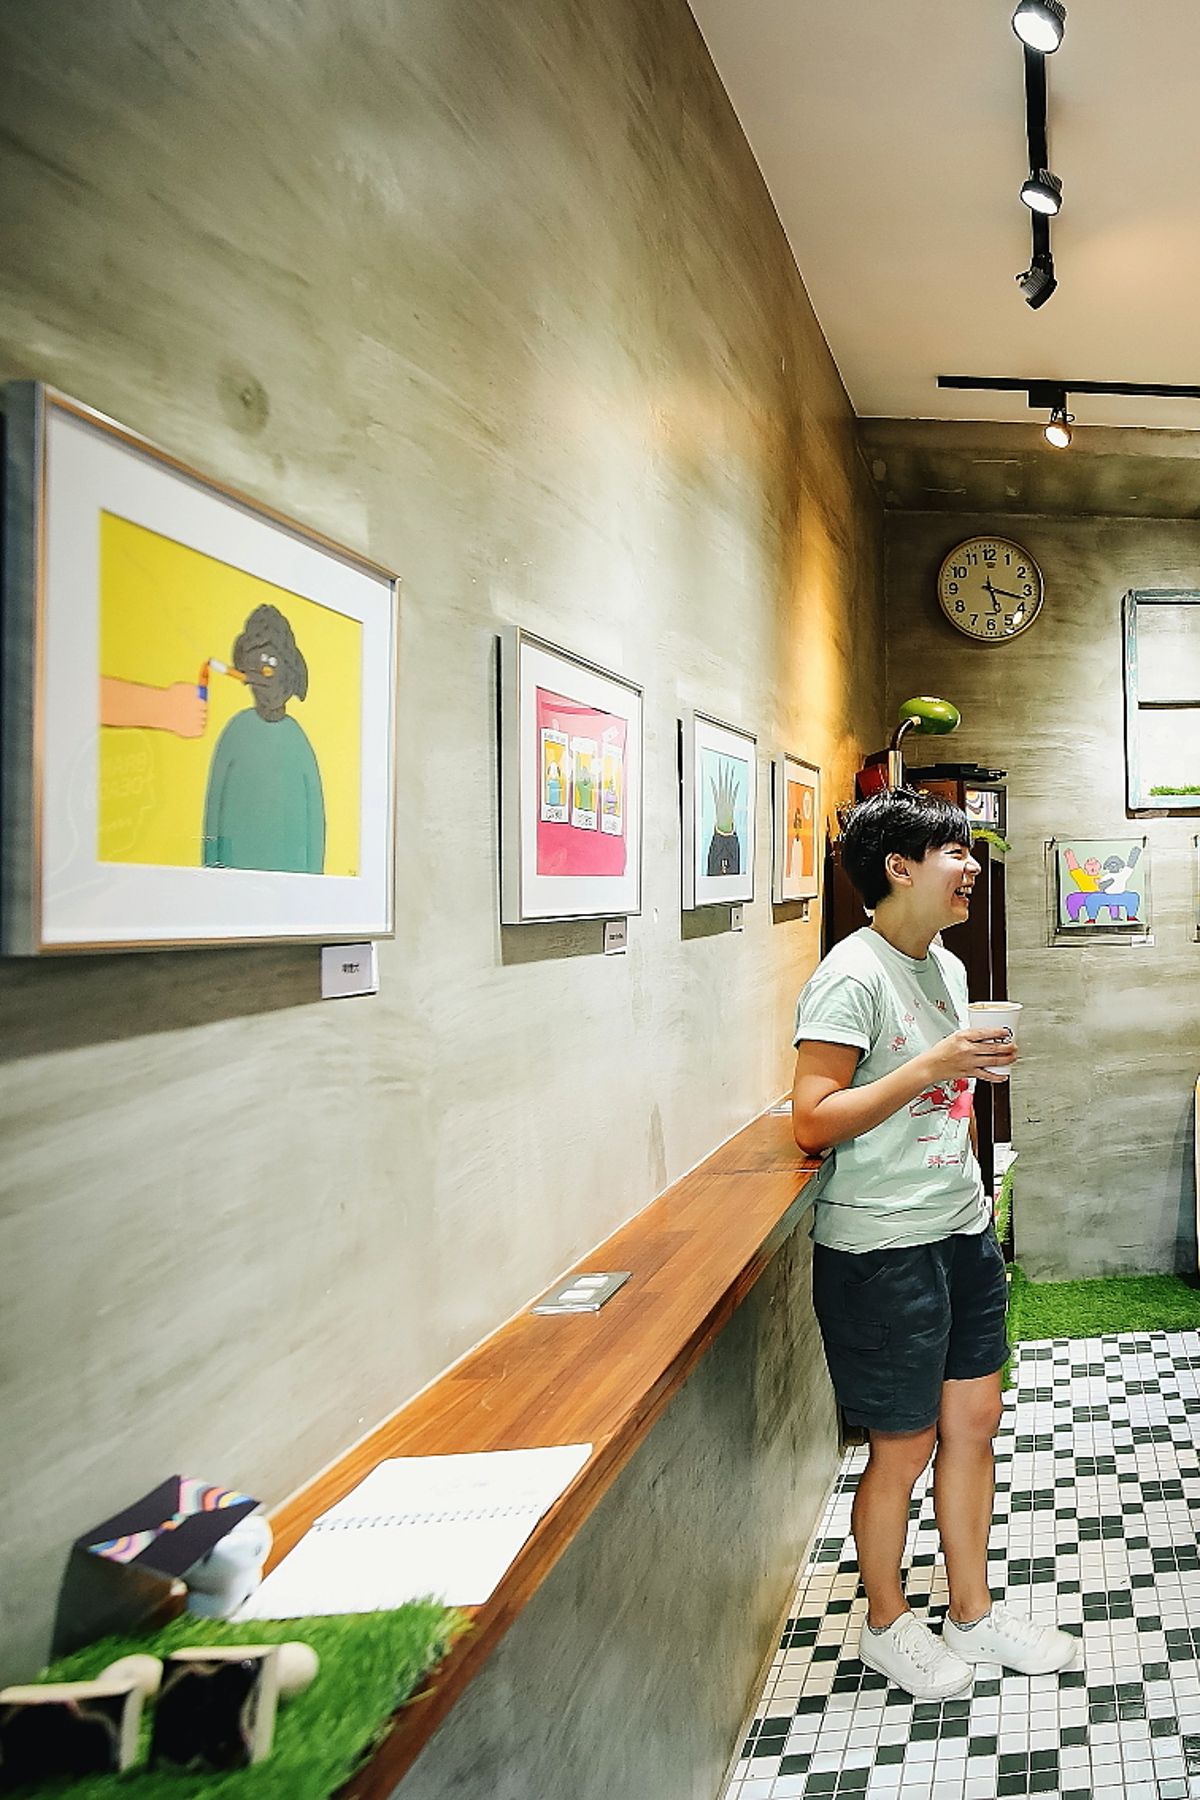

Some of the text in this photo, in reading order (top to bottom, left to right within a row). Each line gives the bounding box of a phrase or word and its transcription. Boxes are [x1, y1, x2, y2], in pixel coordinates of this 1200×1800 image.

[966, 554, 977, 565] 11
[983, 549, 997, 561] 12
[1004, 554, 1011, 566] 1
[951, 566, 967, 579] 10
[1017, 567, 1026, 578] 2
[949, 583, 958, 594] 9
[1023, 584, 1033, 597] 3
[955, 600, 965, 612] 8
[1017, 602, 1027, 614] 4
[970, 614, 978, 625] 7
[987, 619, 996, 630] 6
[1004, 614, 1014, 626] 5
